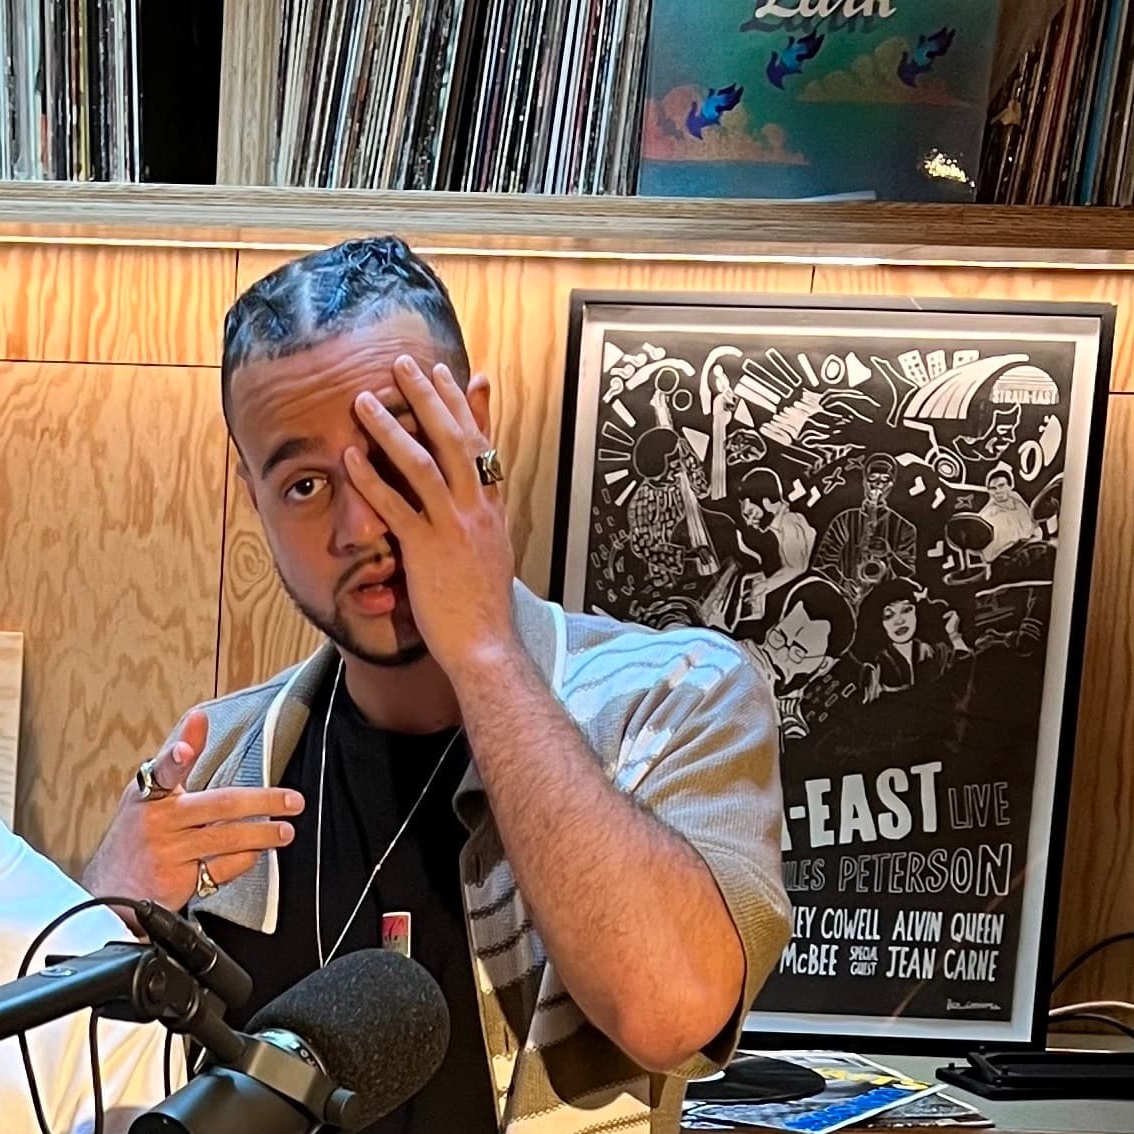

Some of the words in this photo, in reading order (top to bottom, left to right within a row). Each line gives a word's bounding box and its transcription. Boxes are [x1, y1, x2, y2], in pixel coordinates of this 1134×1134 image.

[948, 782, 1011, 829] LIVE
[838, 843, 1013, 897] PETERSON
[821, 908, 881, 941] COWELL
[892, 910, 943, 943] ALVIN
[950, 912, 1005, 945] QUEEN
[779, 943, 840, 976] McBEE
[849, 945, 879, 962] SPECIAL
[849, 961, 878, 977] GUEST
[886, 945, 936, 980] JEAN
[944, 949, 1000, 982] CARNE
